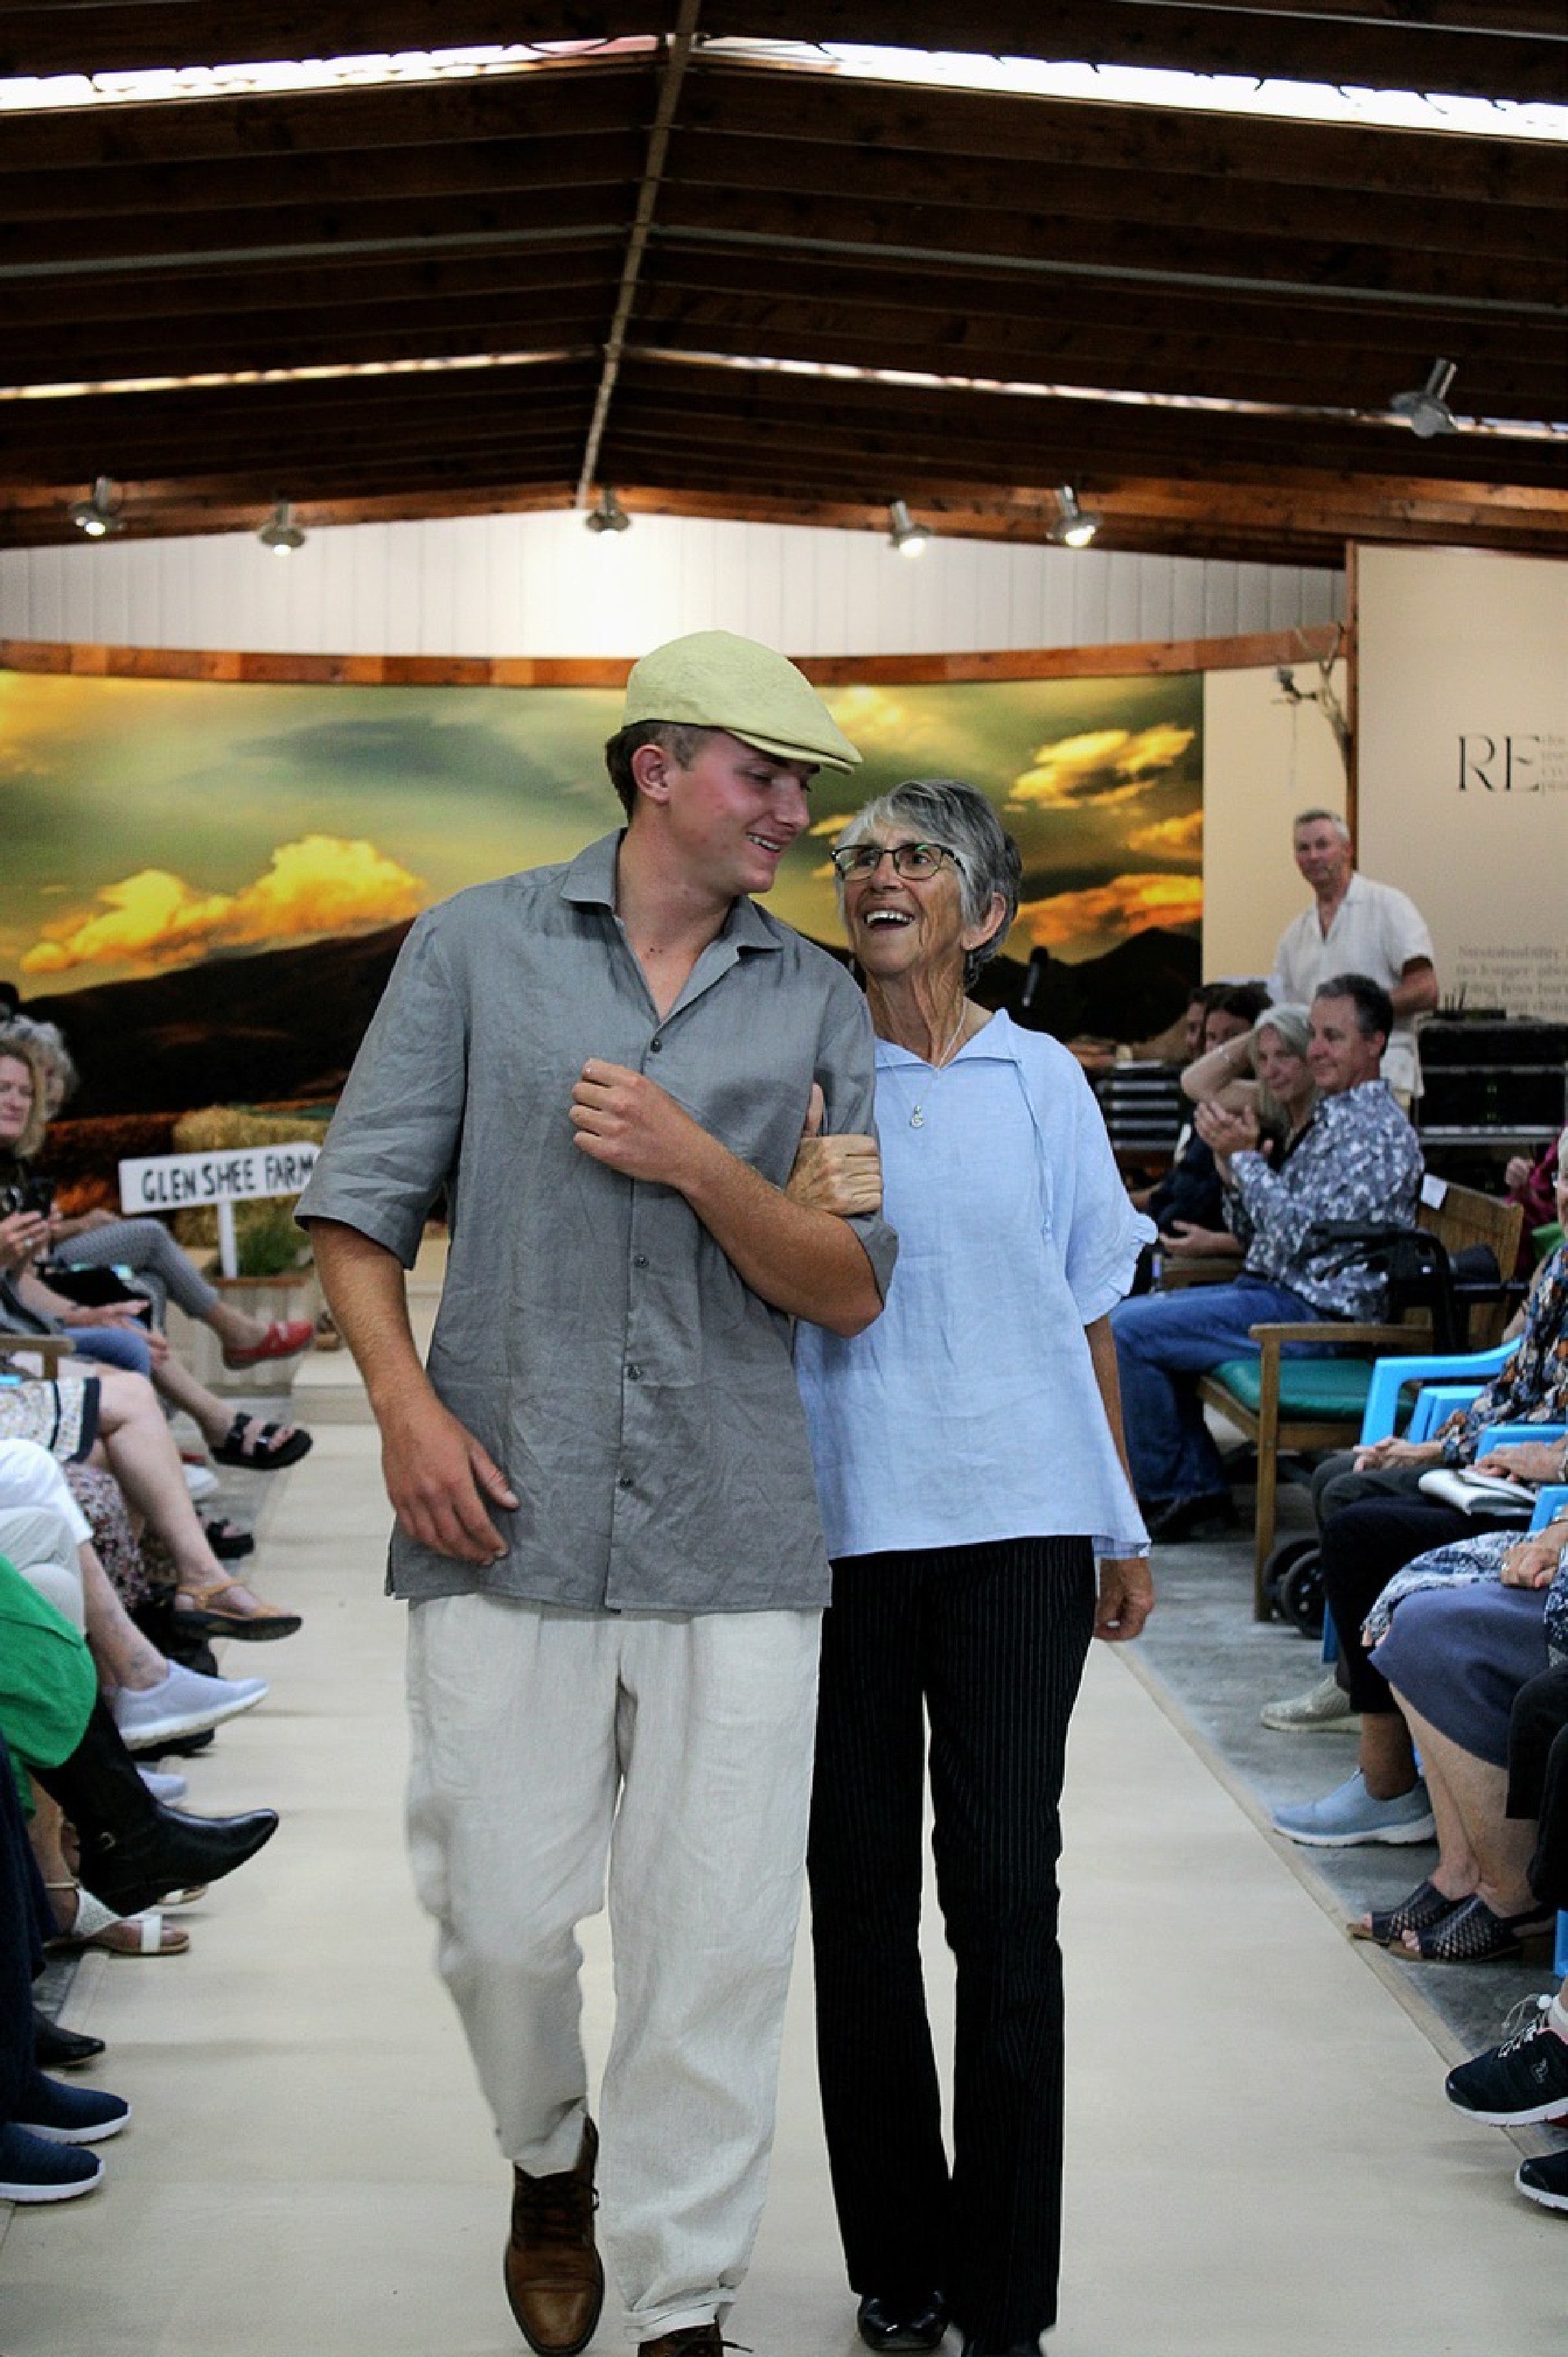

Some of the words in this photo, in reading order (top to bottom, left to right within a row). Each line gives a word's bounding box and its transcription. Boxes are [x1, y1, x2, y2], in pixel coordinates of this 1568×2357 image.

[1458, 734, 1539, 792] RE
[141, 1167, 196, 1203] GLEN
[202, 1159, 256, 1196] SHEE
[264, 1154, 313, 1189] FARM
